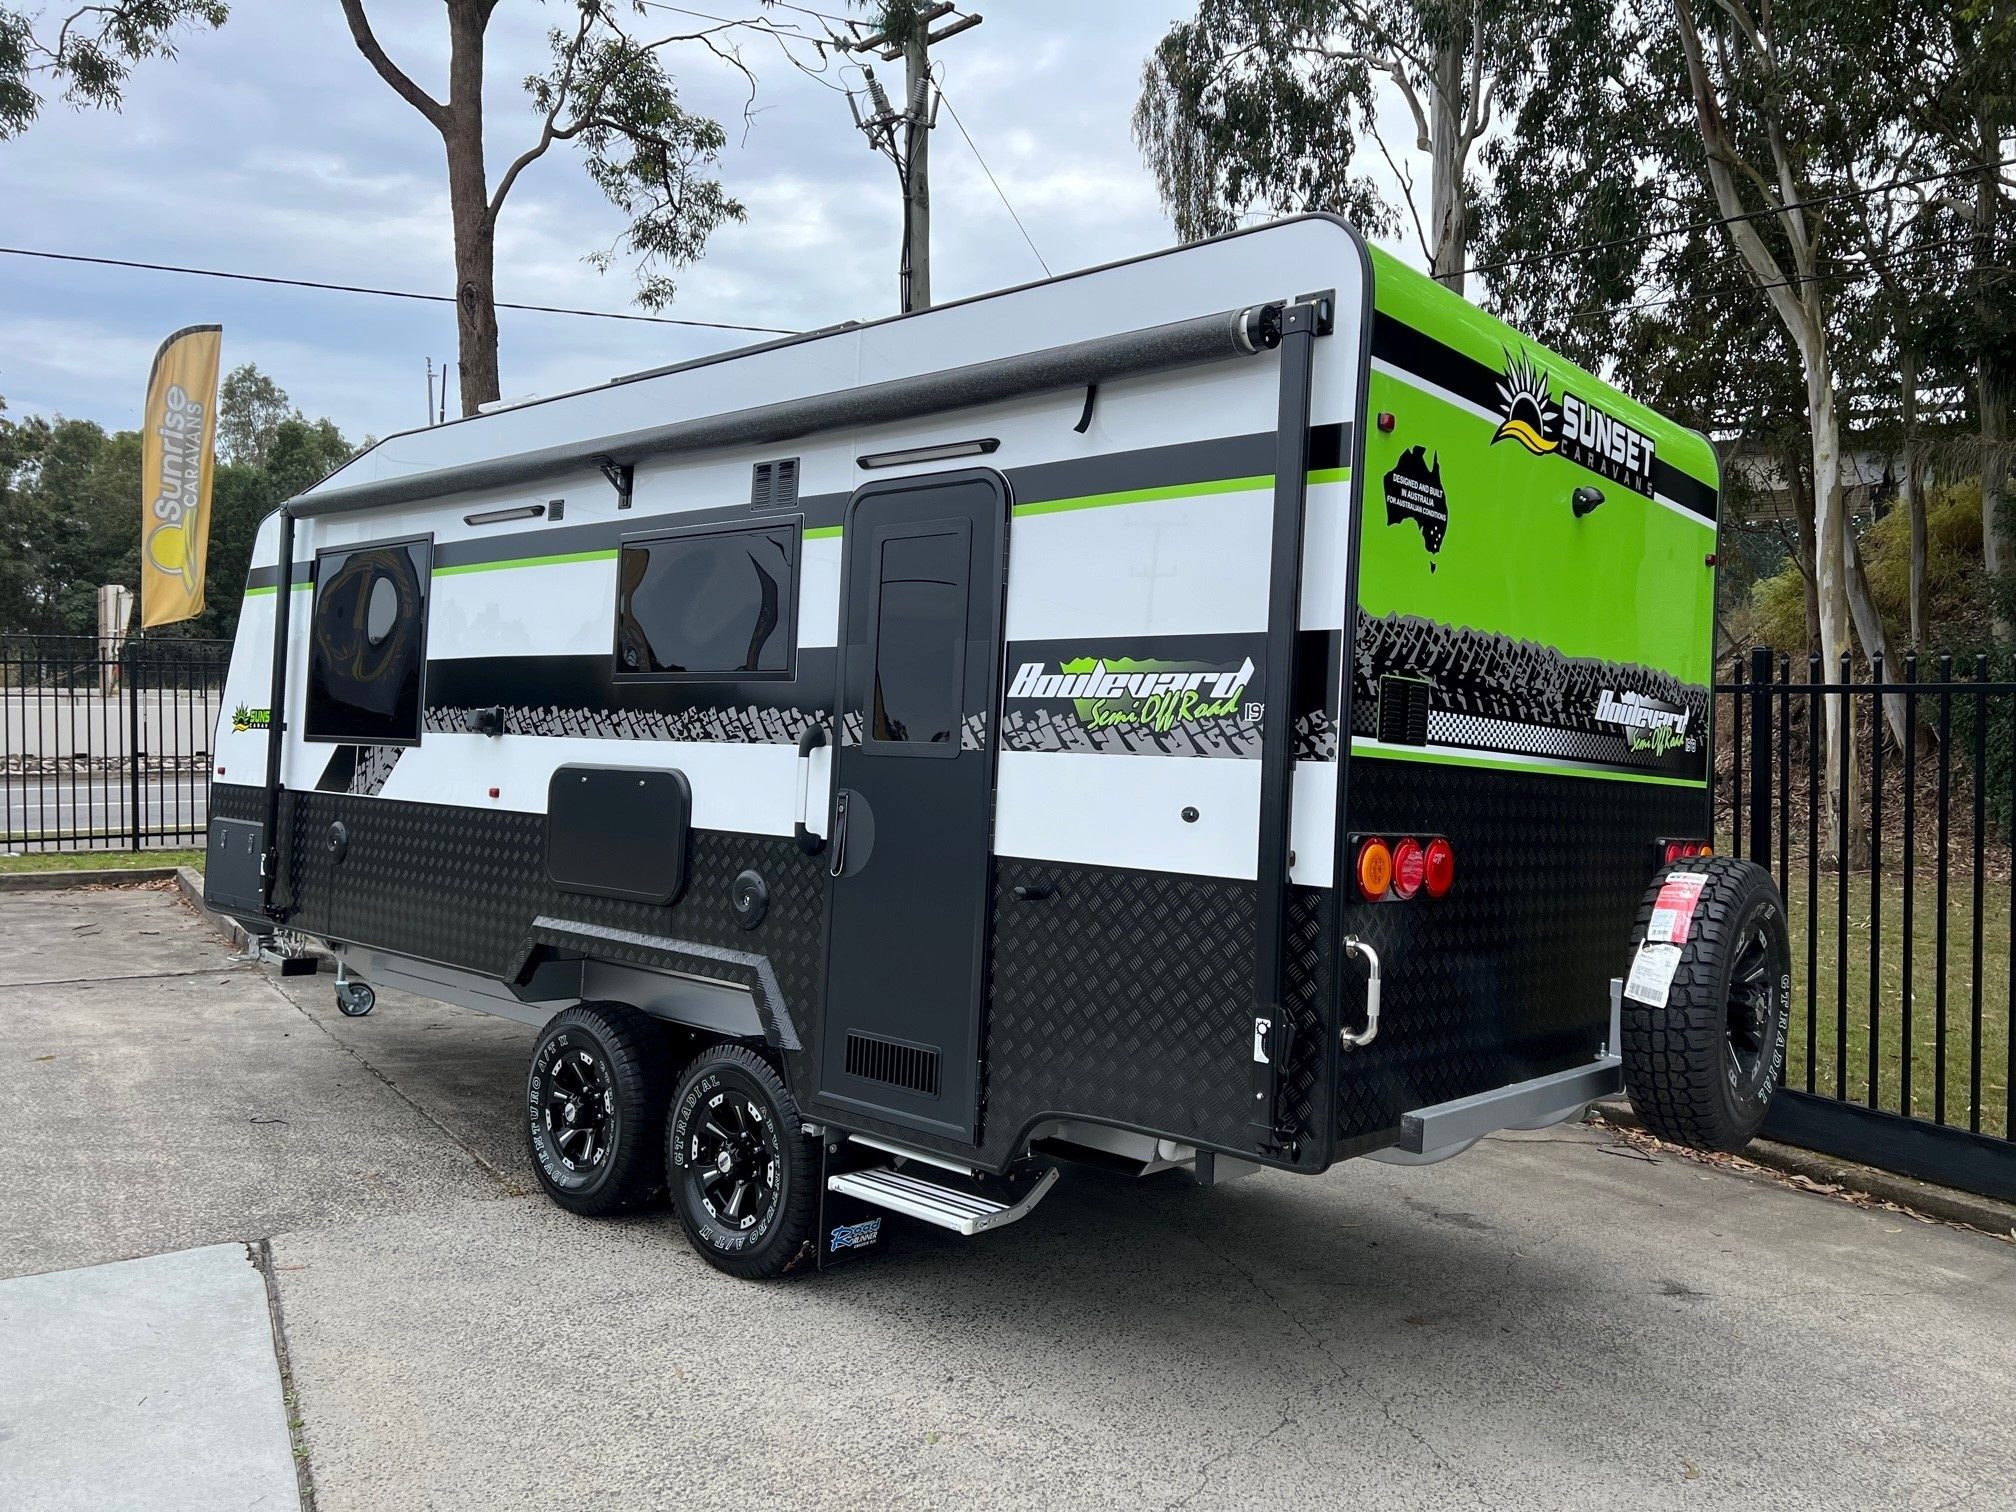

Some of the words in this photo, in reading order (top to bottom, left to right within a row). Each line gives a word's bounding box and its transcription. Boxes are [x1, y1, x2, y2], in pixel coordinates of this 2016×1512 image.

[154, 385, 187, 522] Sunrise
[183, 403, 202, 508] CARAVANS
[1561, 394, 1656, 478] SUNSET
[1392, 473, 1419, 490] DESIGNED
[1418, 482, 1430, 494] AND
[1429, 486, 1443, 499] BUILT
[1560, 438, 1653, 497] CARAVANS
[1387, 495, 1397, 504] FOR
[1396, 498, 1423, 514] AUSTRALIAN
[1422, 507, 1447, 522] CONDITIONS
[1401, 488, 1408, 498] IN
[1407, 490, 1435, 507] AUSTRALIA
[1007, 656, 1255, 699] Boulevard
[249, 710, 271, 723] SUNS
[1088, 697, 1139, 731] Semi
[1140, 690, 1181, 732] Off
[1177, 685, 1244, 722] Road
[1244, 702, 1266, 722] 19
[1594, 689, 1690, 734] Boulevard
[1630, 727, 1652, 753] Semi
[1651, 725, 1666, 757] Off
[1663, 724, 1686, 750] Road
[830, 1216, 882, 1253] Road
